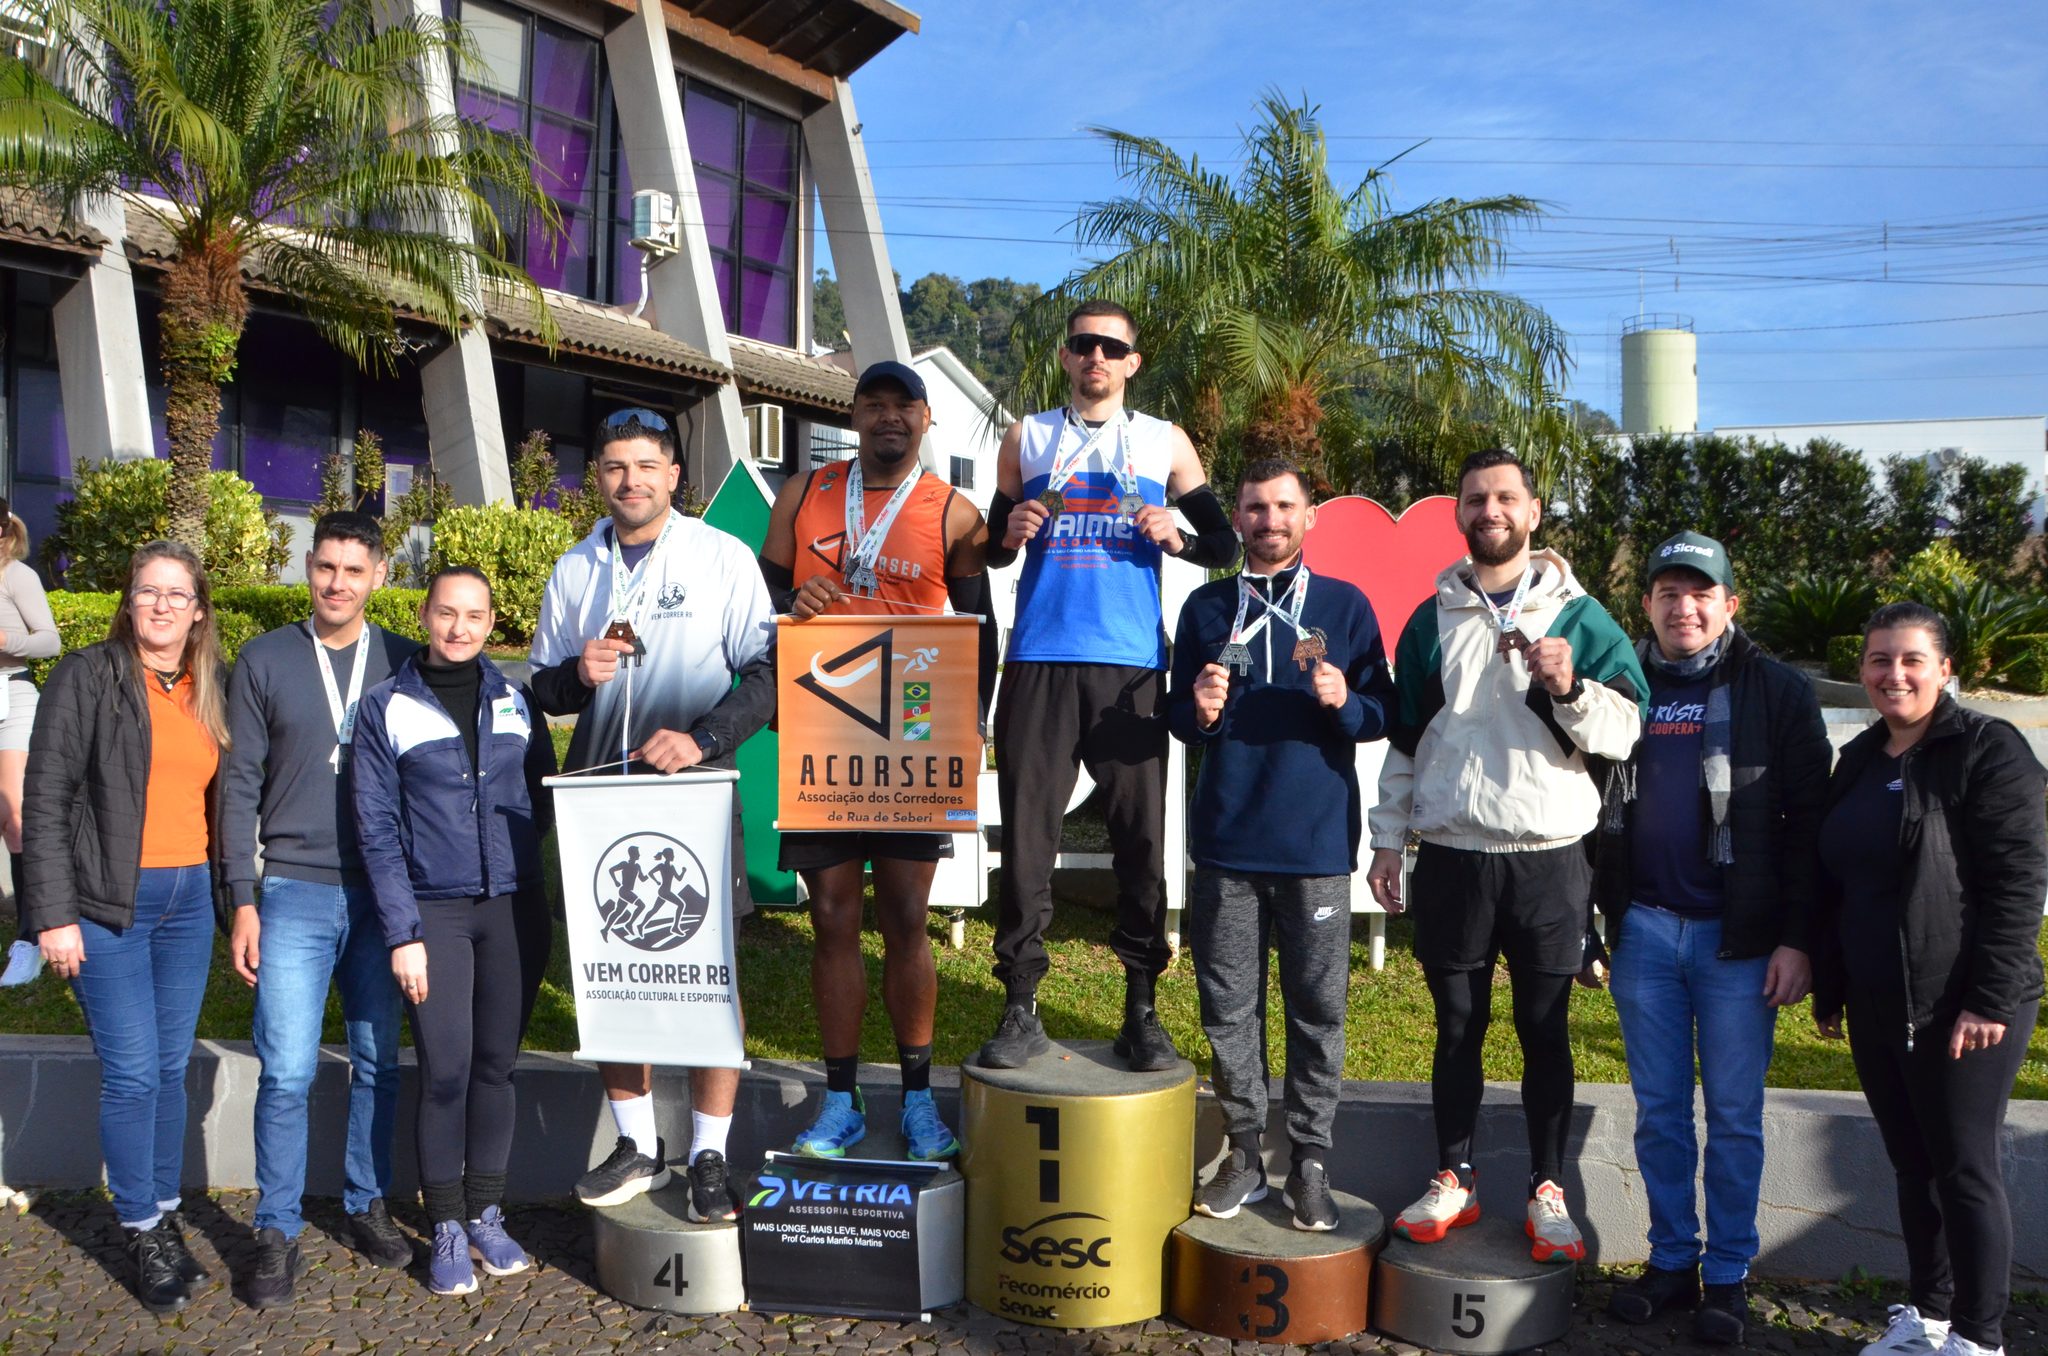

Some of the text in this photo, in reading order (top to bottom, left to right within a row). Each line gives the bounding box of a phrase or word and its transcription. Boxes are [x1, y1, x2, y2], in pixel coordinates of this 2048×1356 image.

[1672, 543, 1715, 558] Sicredi
[799, 754, 964, 788] ACORSEB
[797, 790, 964, 807] Associação dos Corredores
[827, 810, 932, 823] de Rua de Seberi
[582, 962, 731, 986] VEM CORRER RB
[586, 989, 732, 1004] ASSOCIAÇÃO CULTURAL E ESPORTIVA
[1025, 1105, 1060, 1203] 1
[791, 1179, 912, 1205] VETRIA
[788, 1205, 905, 1220] ASSESSORIA ESPORTIVA
[753, 1222, 911, 1240] MAIS LONGE, MAIS LEVE, MAIS VOCÊ!
[781, 1233, 883, 1248] Prof Carlos Manfio Martins
[1000, 1211, 1112, 1270] Sesc
[653, 1252, 689, 1297] 4
[999, 1273, 1111, 1300] Fecomércio
[1000, 1296, 1056, 1321] Senac
[1239, 1263, 1290, 1338] 3
[1451, 1292, 1486, 1340] 5
